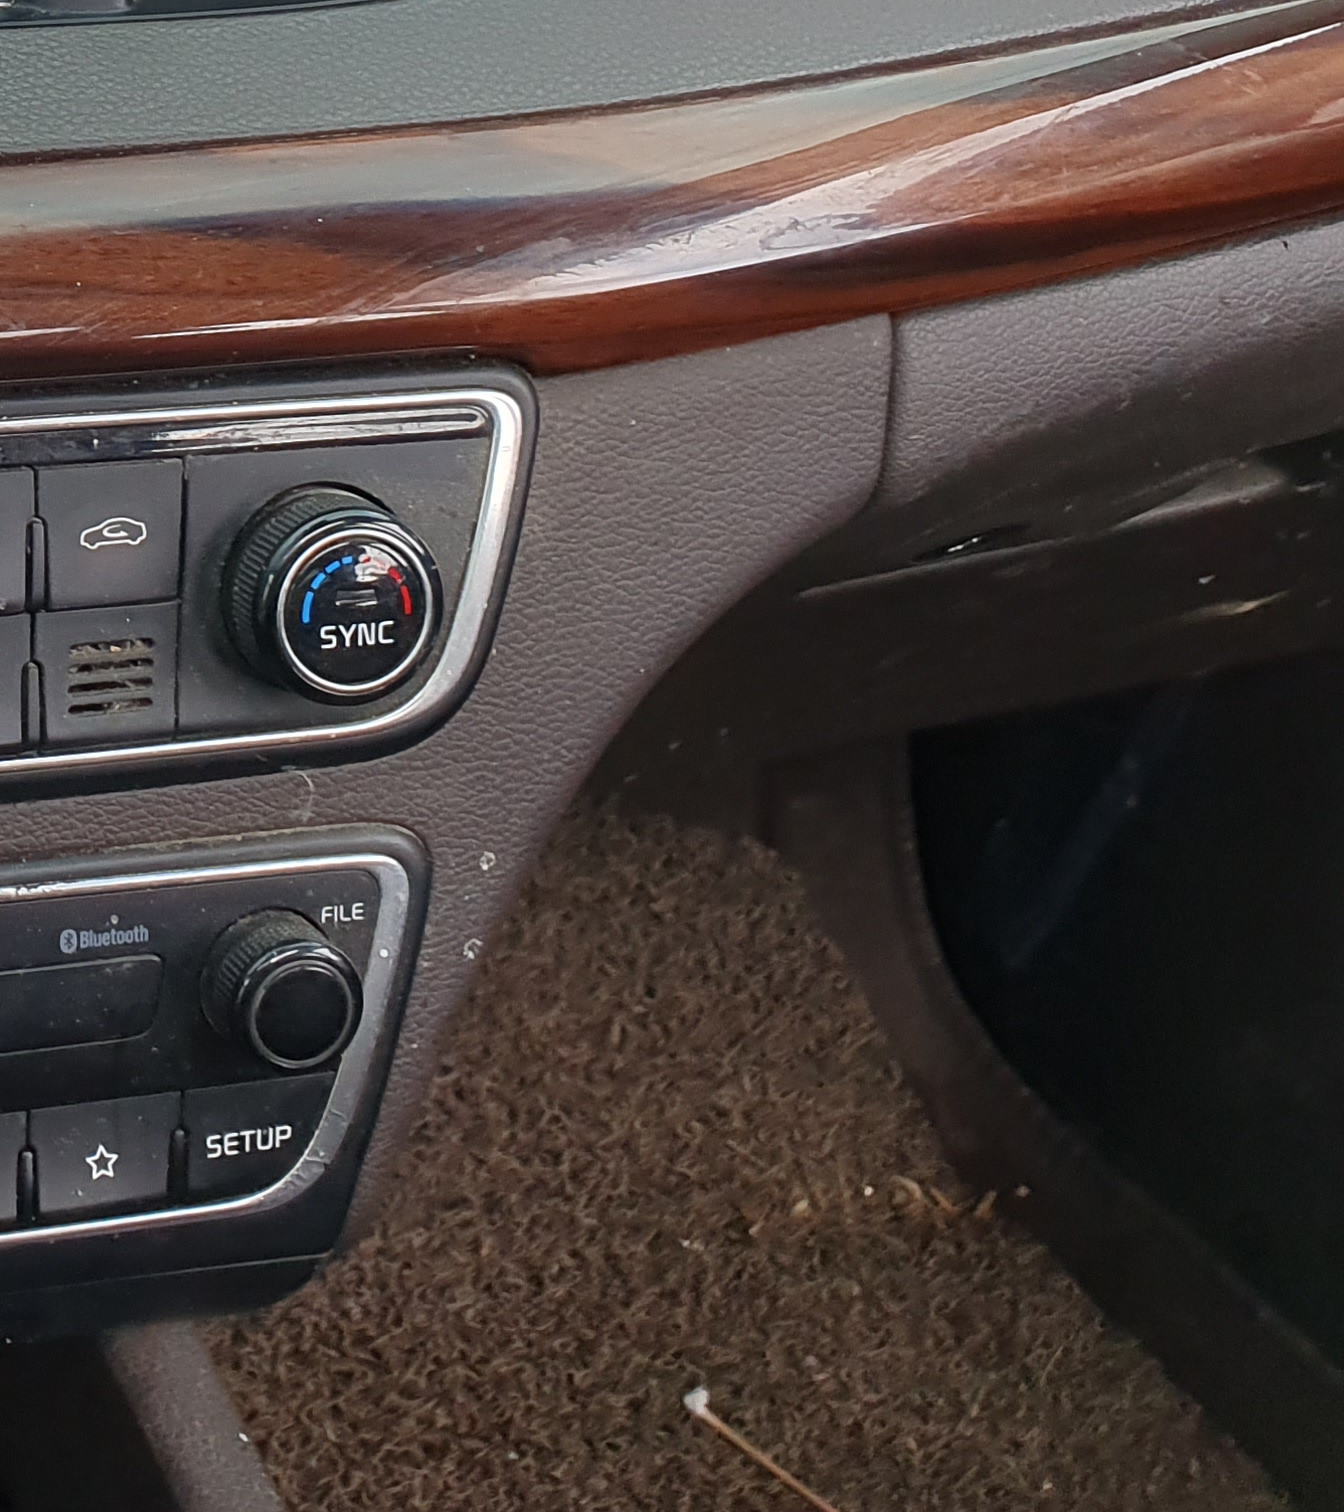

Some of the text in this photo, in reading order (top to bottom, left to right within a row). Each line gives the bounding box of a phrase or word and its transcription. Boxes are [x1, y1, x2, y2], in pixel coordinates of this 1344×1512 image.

[321, 620, 395, 650] SYNC
[320, 902, 365, 923] FILE
[79, 925, 150, 949] Bluetooth
[206, 1125, 293, 1159] SETUP
